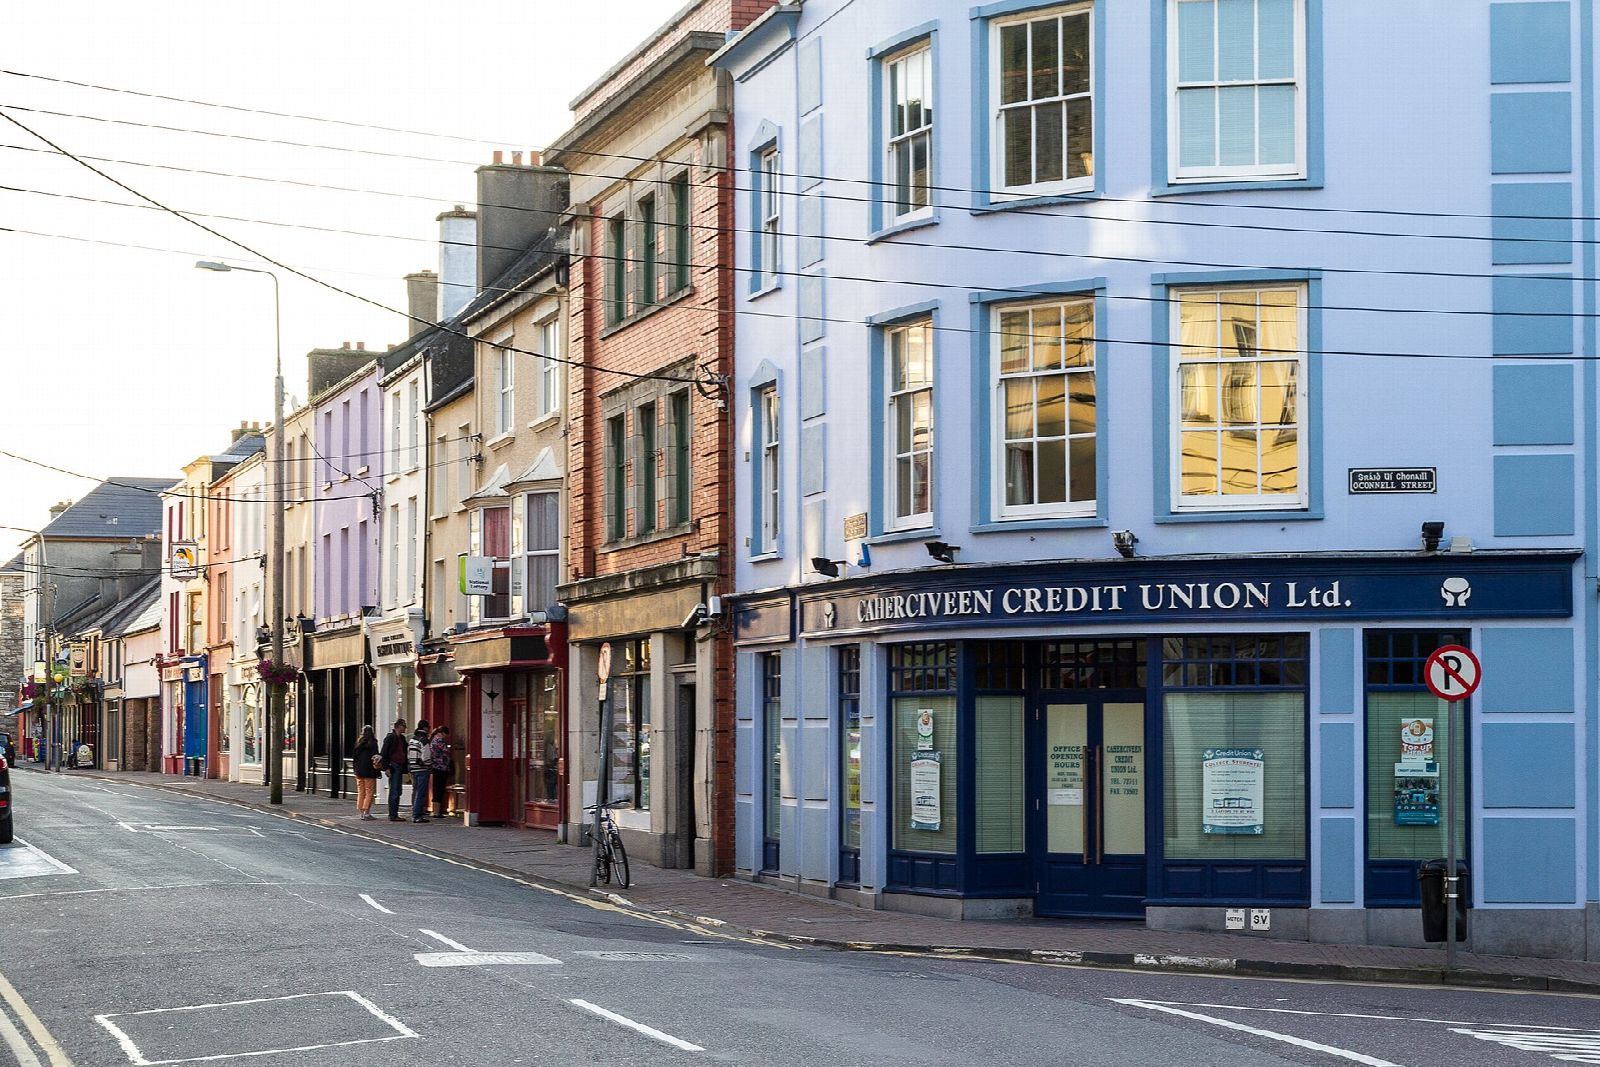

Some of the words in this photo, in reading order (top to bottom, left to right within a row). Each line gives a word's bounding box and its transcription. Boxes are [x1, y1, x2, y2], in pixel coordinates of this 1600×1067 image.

[1353, 481, 1396, 489] OCONNELL
[1401, 481, 1433, 489] STREET
[857, 589, 993, 623] CAHERCIVEEN
[1002, 586, 1127, 614] CREDIT
[1139, 582, 1271, 610] UNION
[1286, 580, 1352, 608] Ltd.
[1444, 656, 1461, 690] P
[1215, 749, 1234, 757] Credit
[1115, 755, 1133, 763] CREDIT
